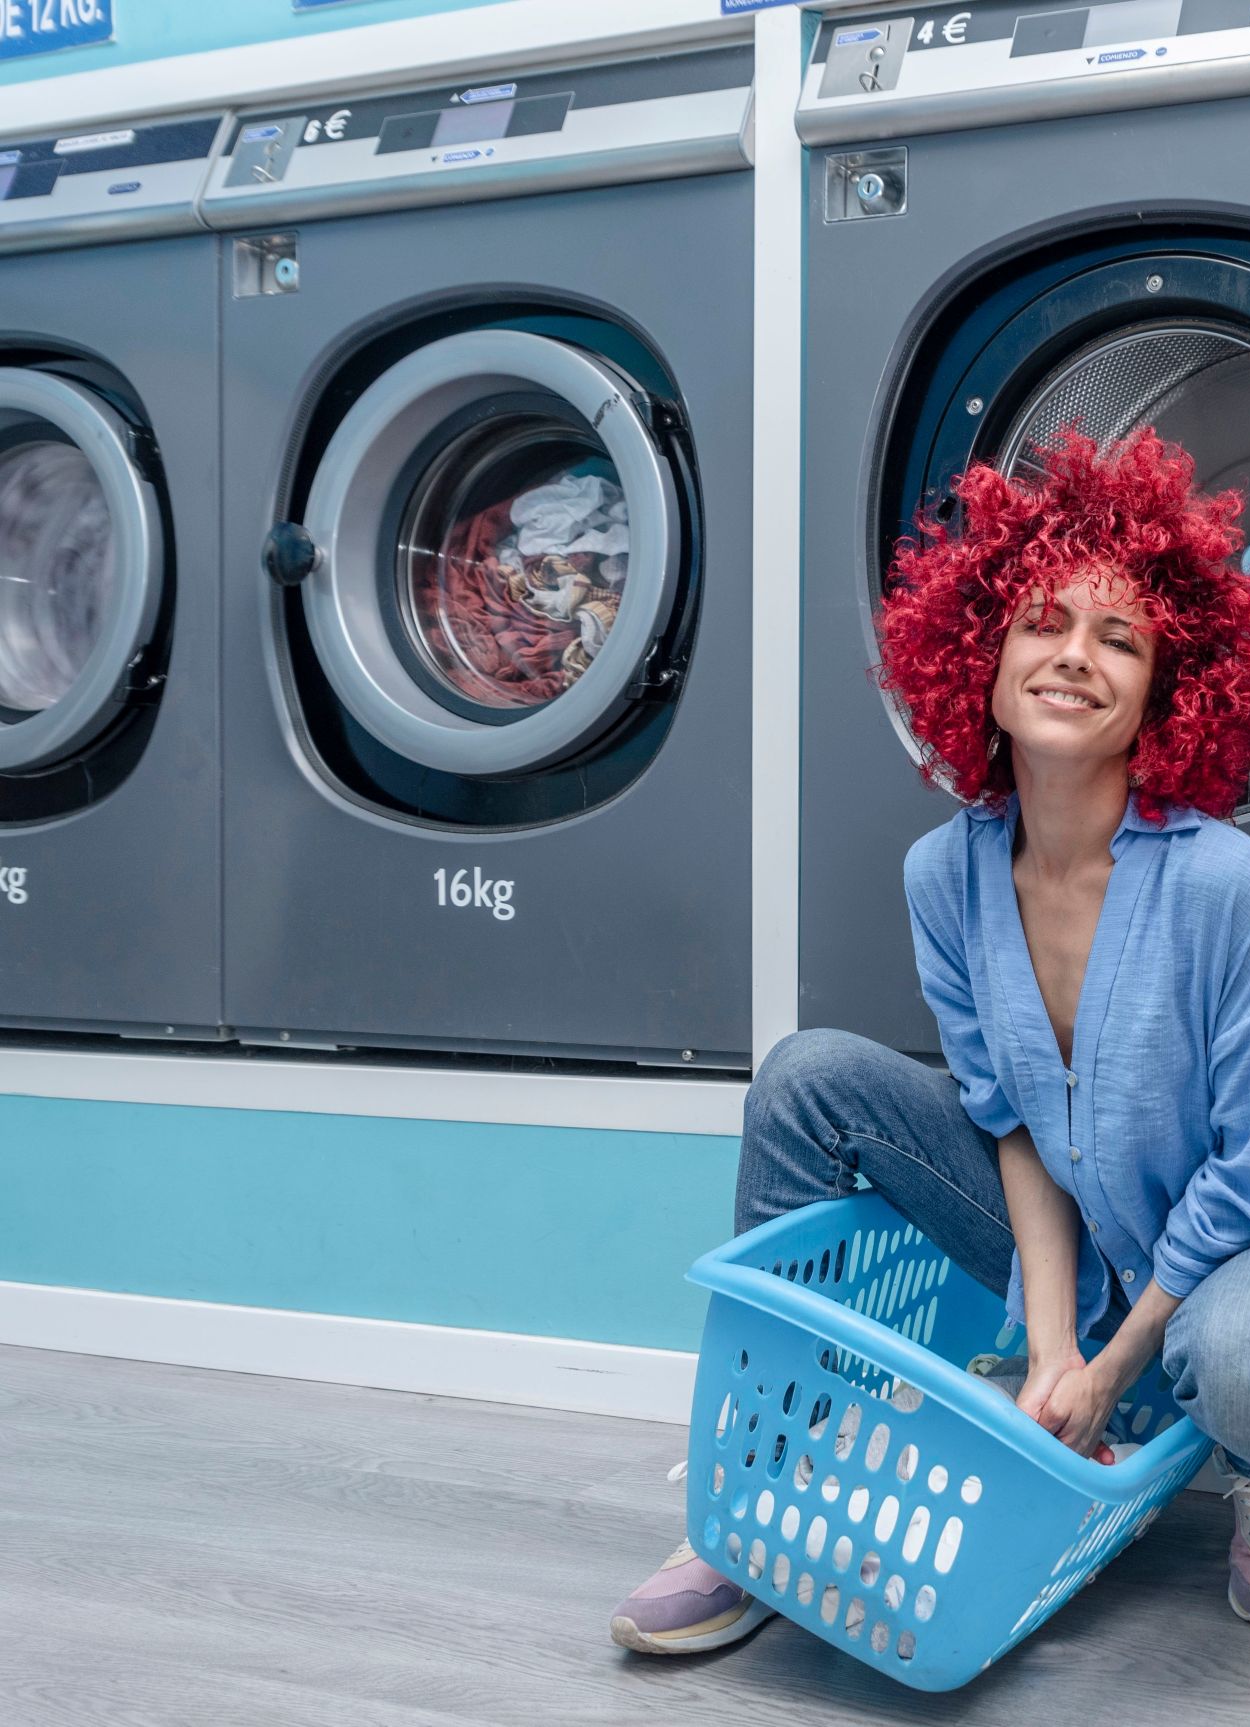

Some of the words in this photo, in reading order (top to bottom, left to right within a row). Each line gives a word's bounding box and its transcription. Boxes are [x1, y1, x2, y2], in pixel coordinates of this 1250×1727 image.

[0, 0, 23, 37] E
[917, 20, 935, 45] 4
[942, 12, 972, 44] €
[1100, 51, 1138, 63] COMIENZO
[433, 866, 516, 920] 16kg
